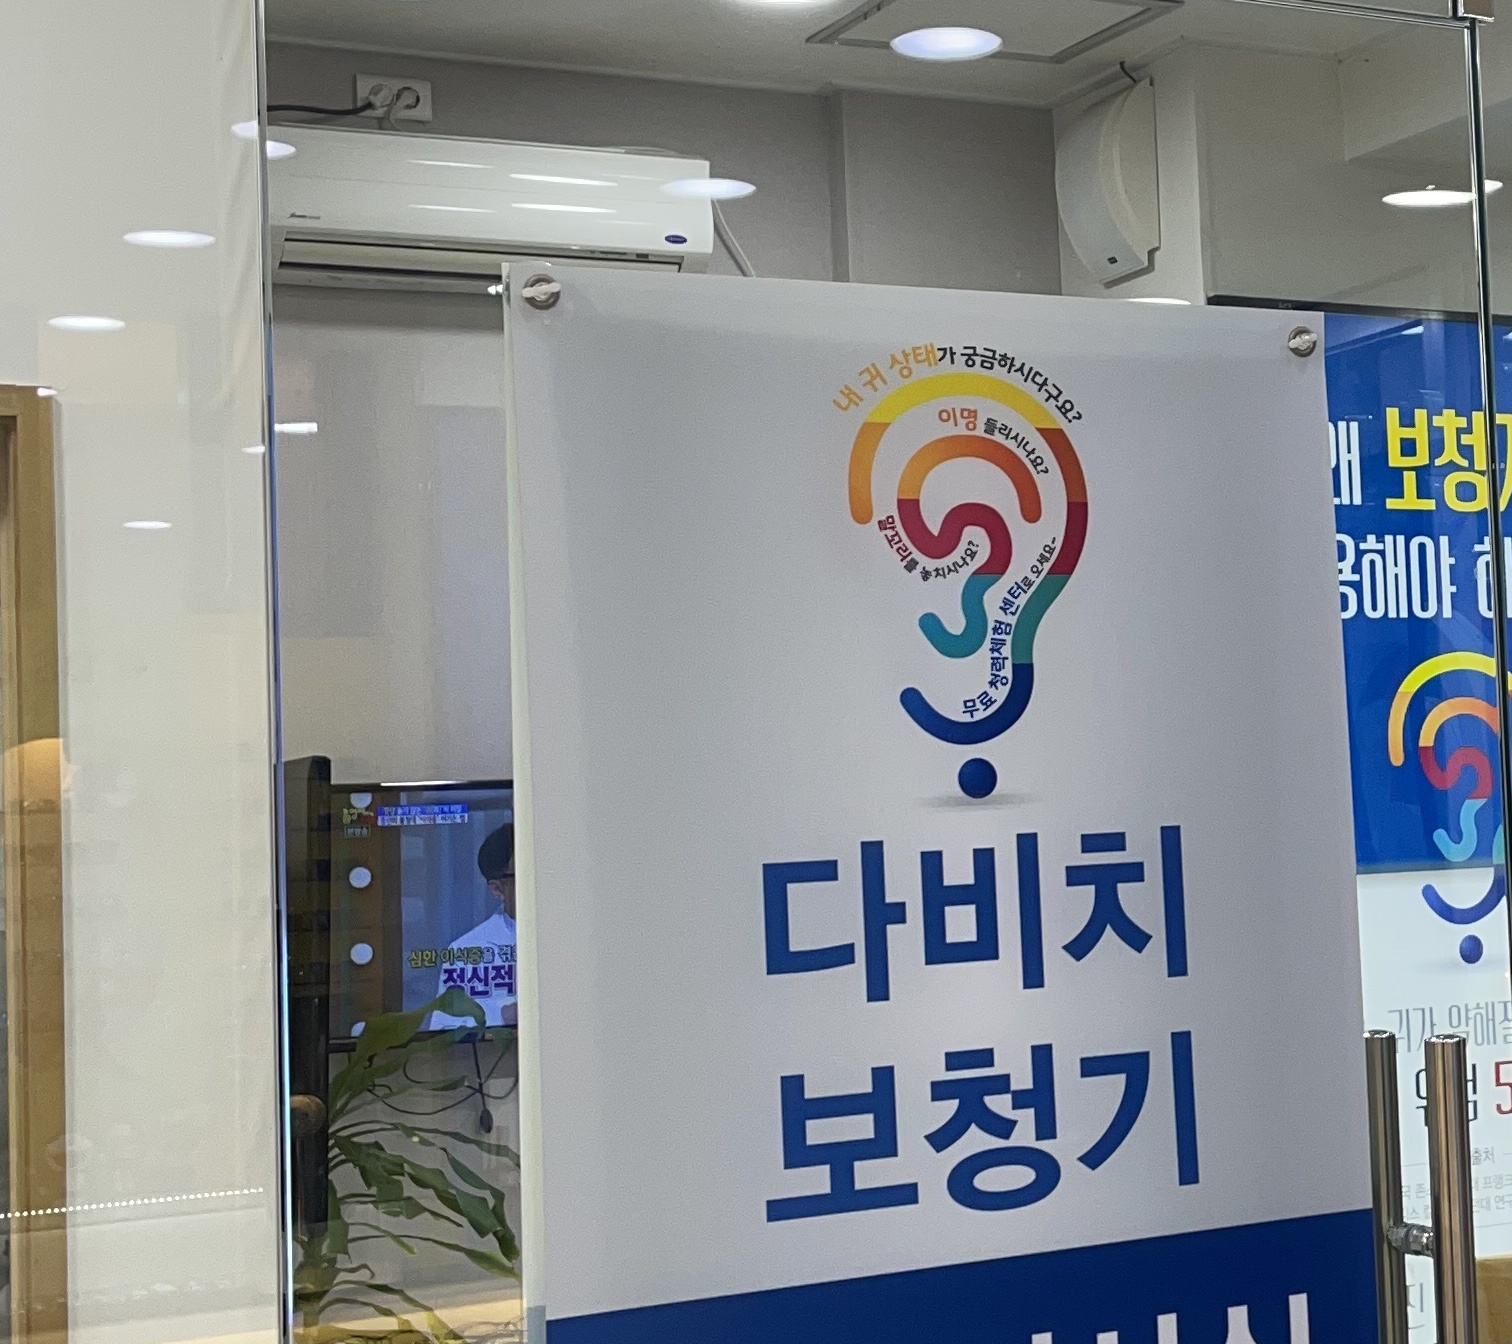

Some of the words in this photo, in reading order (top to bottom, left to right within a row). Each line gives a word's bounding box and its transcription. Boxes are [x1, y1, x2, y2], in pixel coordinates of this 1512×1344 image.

[833, 384, 864, 411] 내
[859, 363, 888, 392] 귀
[889, 343, 956, 378] 상태가
[960, 346, 1082, 423] 궁금하시다구요?
[938, 407, 978, 431] 이명
[983, 418, 1049, 474] 들리시나요?
[999, 576, 1035, 616] 센터로
[988, 619, 1012, 689] 청력체험
[962, 691, 997, 718] 무료
[761, 825, 1189, 1002] 다비치
[766, 1030, 1201, 1223] 보청기
